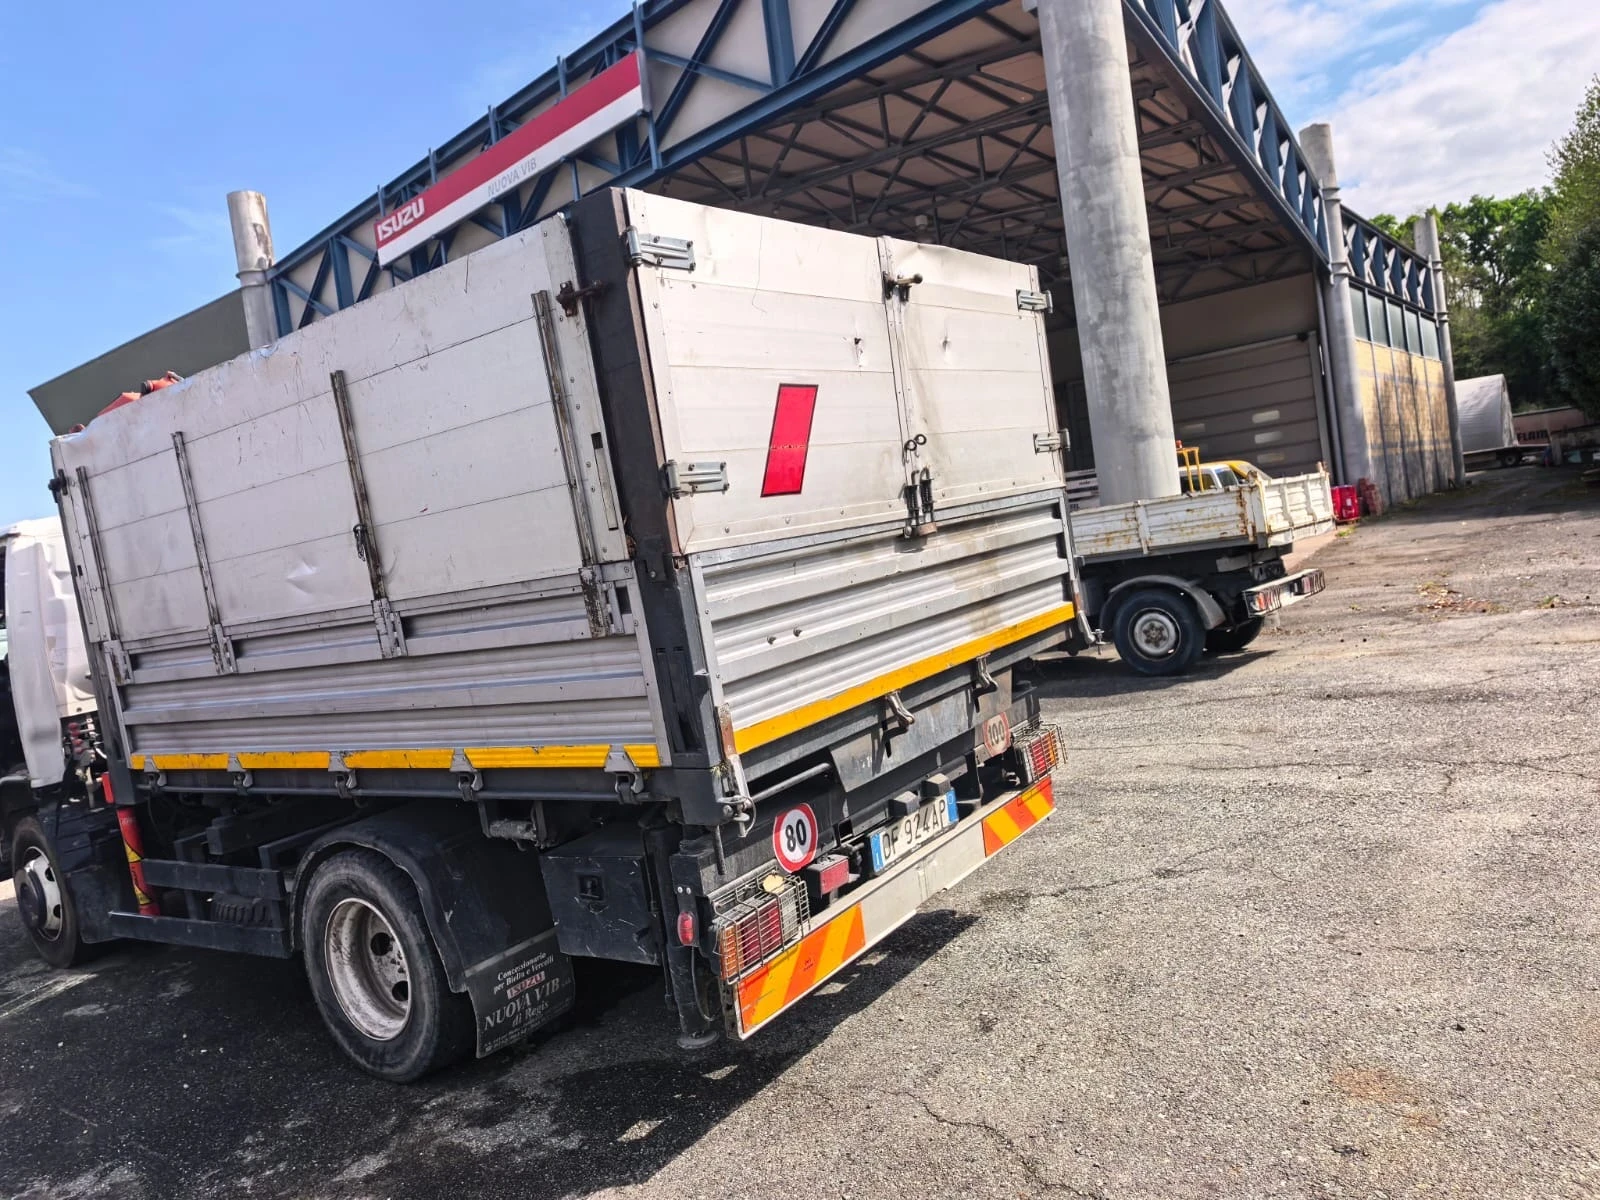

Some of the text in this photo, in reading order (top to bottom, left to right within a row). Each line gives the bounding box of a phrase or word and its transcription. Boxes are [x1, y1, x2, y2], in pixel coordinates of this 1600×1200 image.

[487, 158, 537, 197] NUOVA VIB
[377, 197, 425, 242] ISUZU
[988, 720, 1005, 746] 100
[785, 818, 807, 852] 80
[882, 799, 946, 860] DF 924AP
[493, 981, 505, 995] per
[508, 973, 544, 998] ISUZU
[484, 992, 532, 1031] NUOVA
[534, 977, 560, 1001] VIB
[512, 1012, 522, 1028] di
